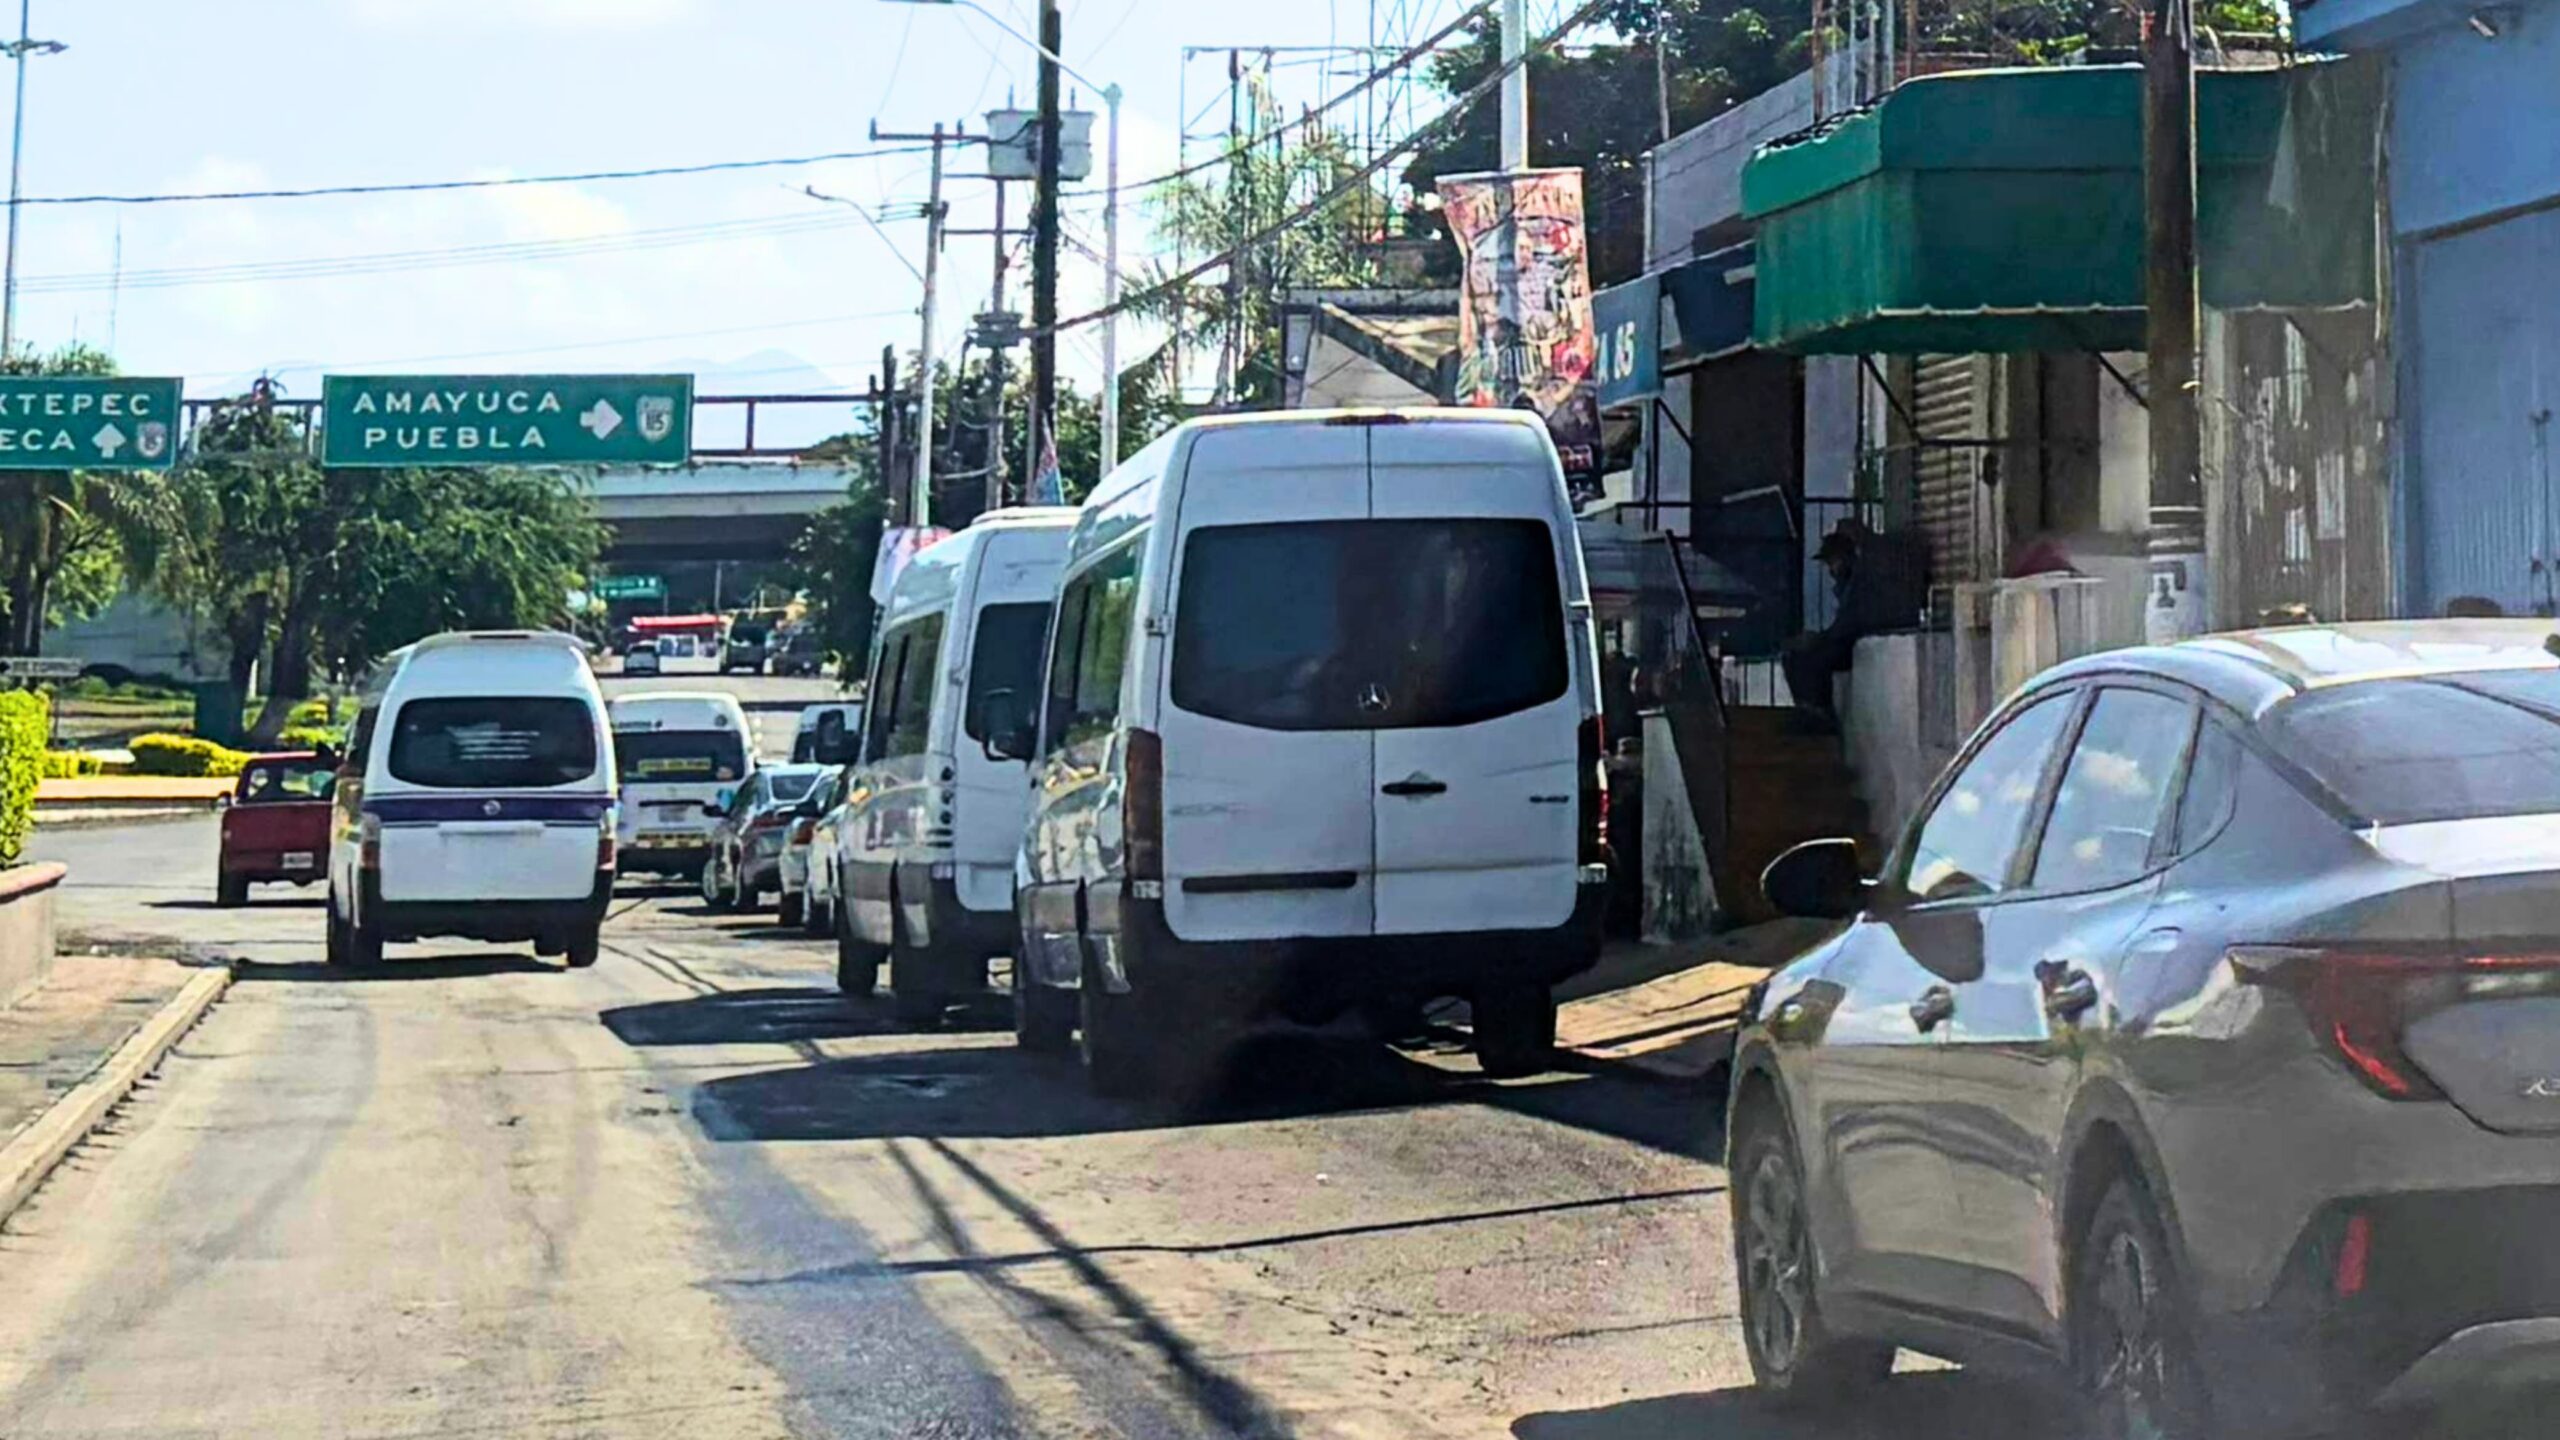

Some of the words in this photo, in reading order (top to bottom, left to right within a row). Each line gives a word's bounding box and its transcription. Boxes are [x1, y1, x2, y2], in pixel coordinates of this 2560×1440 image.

[352, 391, 562, 414] AMAYUCA
[0, 428, 76, 451] ECA
[364, 426, 546, 449] PUEBLA
